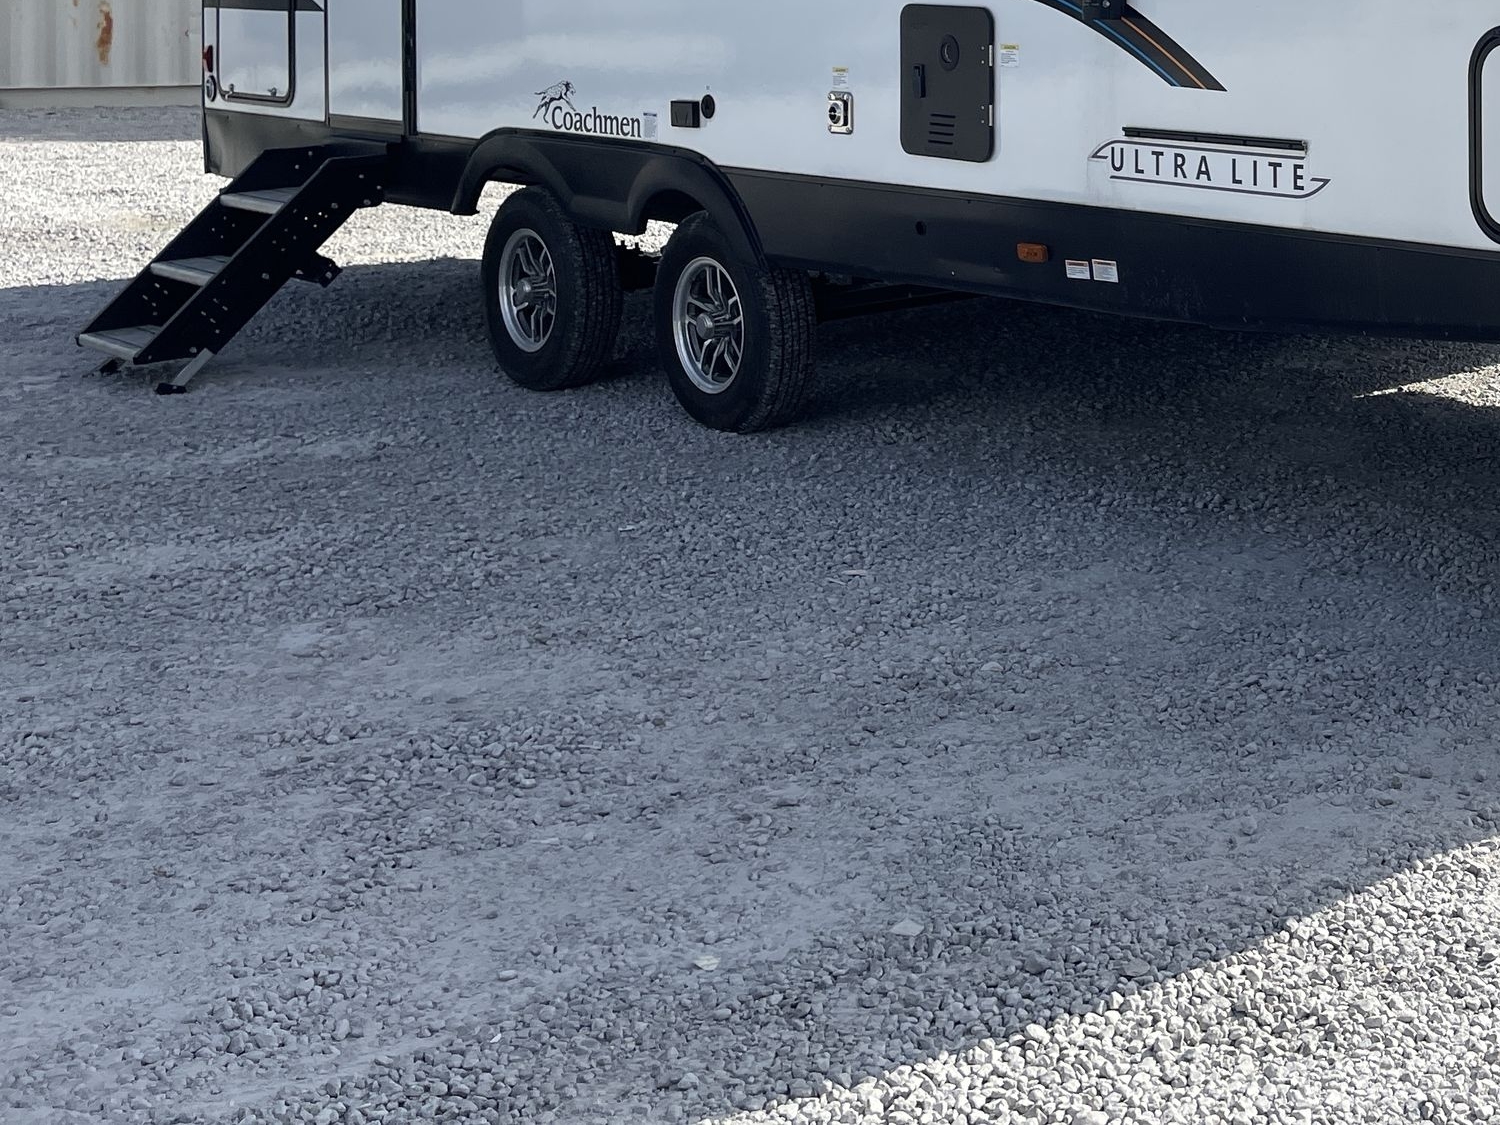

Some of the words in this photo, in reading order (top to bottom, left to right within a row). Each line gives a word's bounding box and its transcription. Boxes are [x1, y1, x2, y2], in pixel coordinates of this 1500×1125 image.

[551, 106, 642, 138] Coachmen
[1110, 146, 1212, 182] ULTRA
[1231, 158, 1305, 191] LITE
